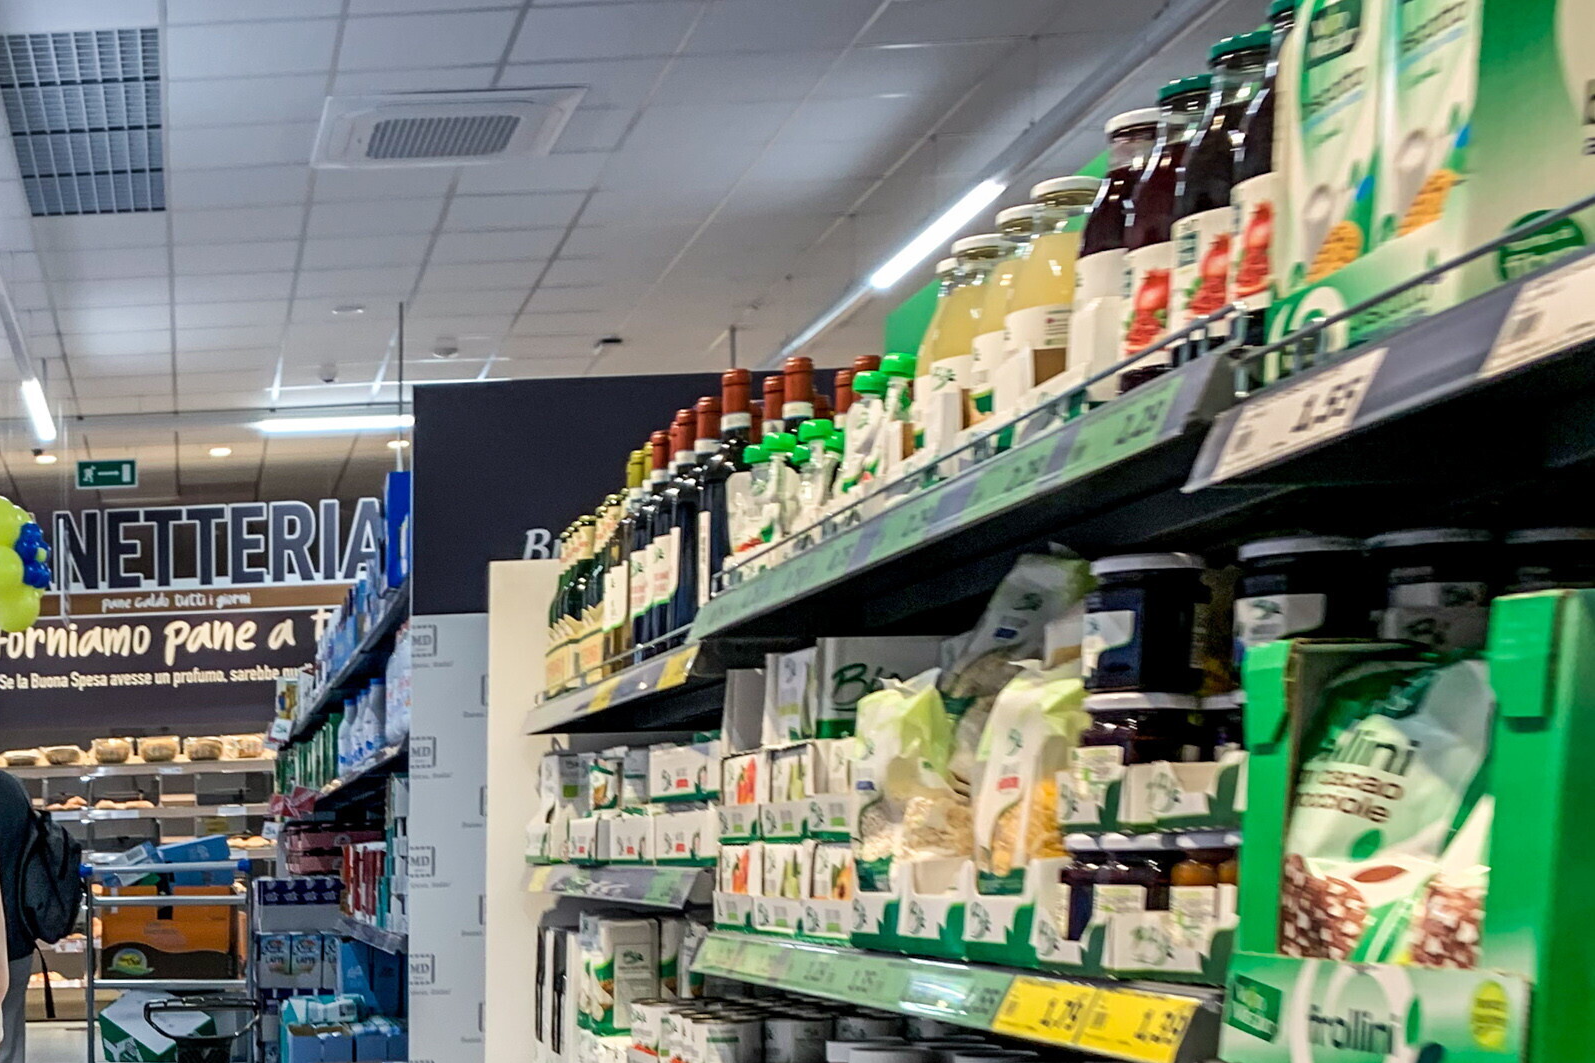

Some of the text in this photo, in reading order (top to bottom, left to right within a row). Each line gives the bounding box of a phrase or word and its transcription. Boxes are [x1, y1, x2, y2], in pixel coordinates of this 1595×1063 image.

[101, 598, 132, 614] pane
[174, 592, 206, 608] tutti
[216, 591, 252, 610] giorni
[164, 619, 258, 667] pane
[267, 618, 297, 651] a
[16, 672, 29, 689] la
[30, 672, 69, 689] Buona
[71, 670, 107, 692] Spesa
[110, 672, 153, 687] avesse
[154, 672, 171, 686] un
[173, 666, 229, 689] profumo,
[230, 664, 280, 684] sarebbe
